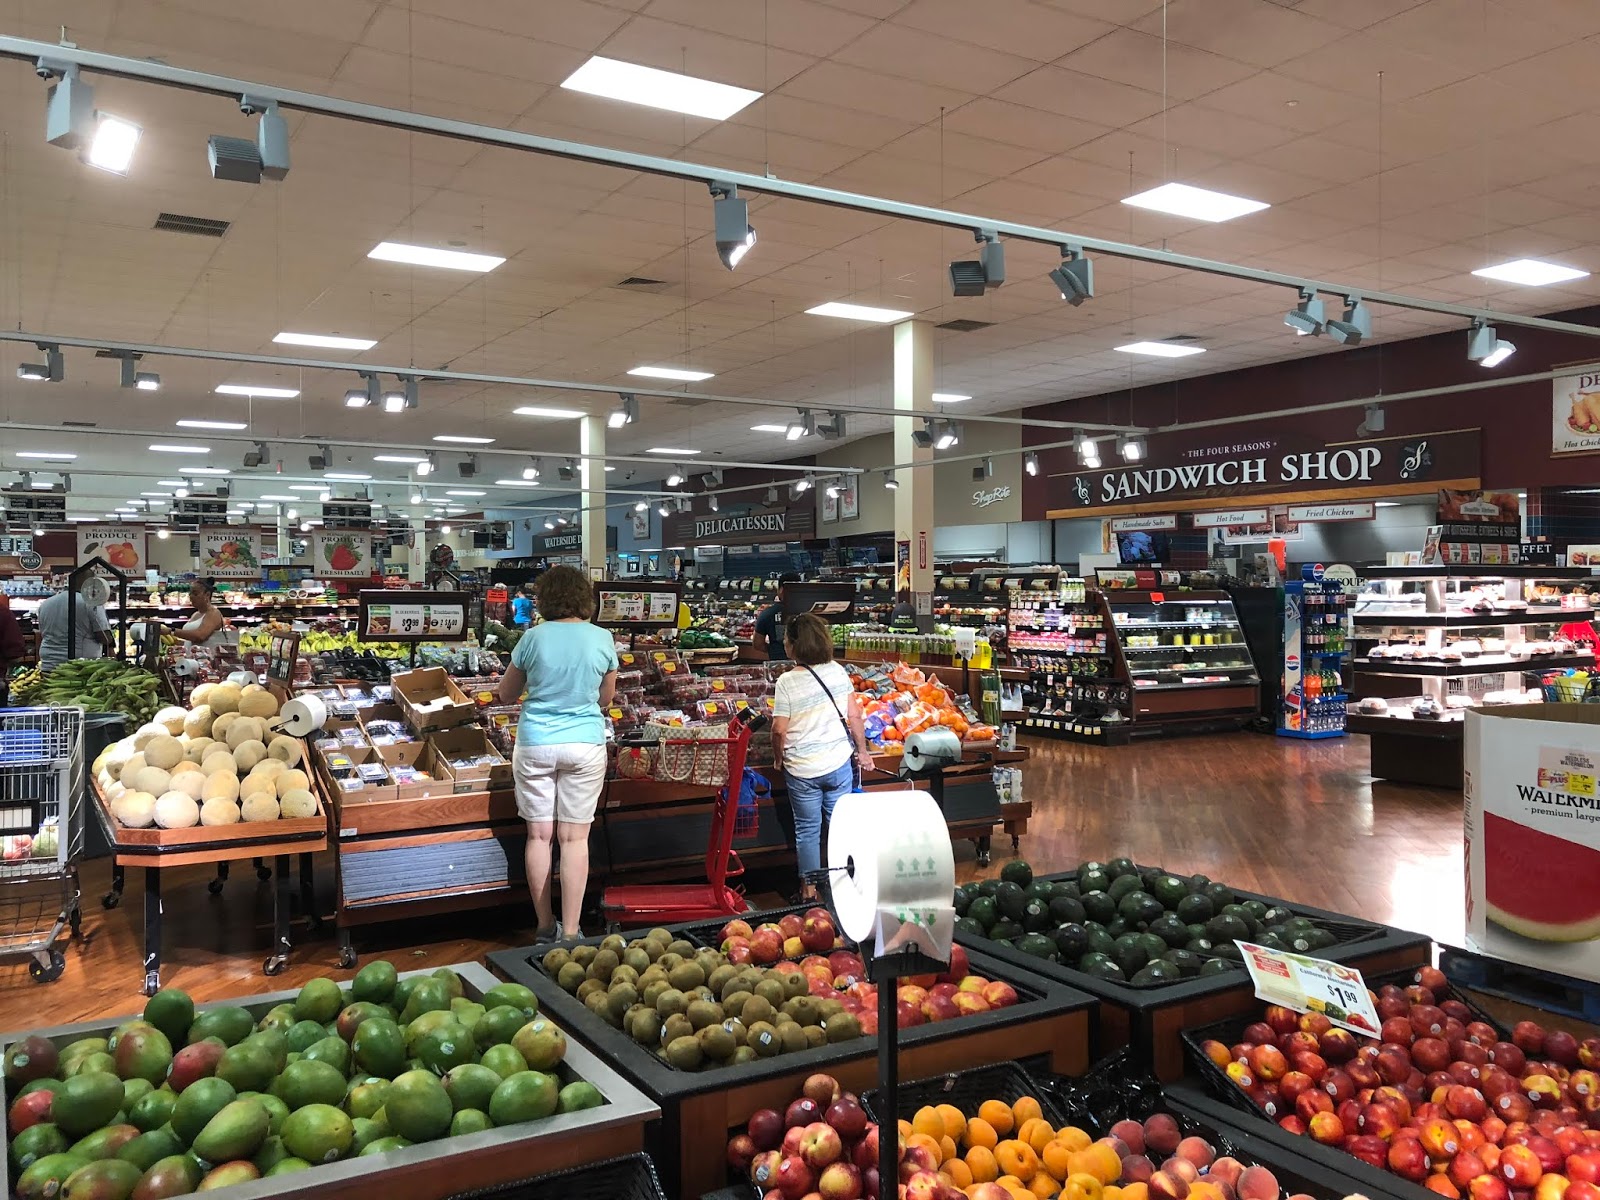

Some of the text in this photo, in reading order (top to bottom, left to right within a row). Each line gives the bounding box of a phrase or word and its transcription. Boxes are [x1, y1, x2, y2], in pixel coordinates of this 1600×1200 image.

[1187, 441, 1271, 458] THE FOUR SEASONS
[1101, 447, 1382, 502] SANDWICH SHOP
[972, 486, 1011, 507] ShopRite
[1216, 513, 1245, 522] Hot Food
[1305, 507, 1355, 518] Fried Chicken
[695, 513, 786, 539] DELICATESSEN
[1122, 518, 1151, 529] Handmade
[85, 532, 138, 540] PRODUCE
[207, 535, 255, 543] PRODUCE
[321, 536, 366, 544] PRODUCE
[544, 534, 577, 549] WATERSIDE
[1549, 776, 1569, 784] PLUS
[1531, 807, 1600, 823] premium large
